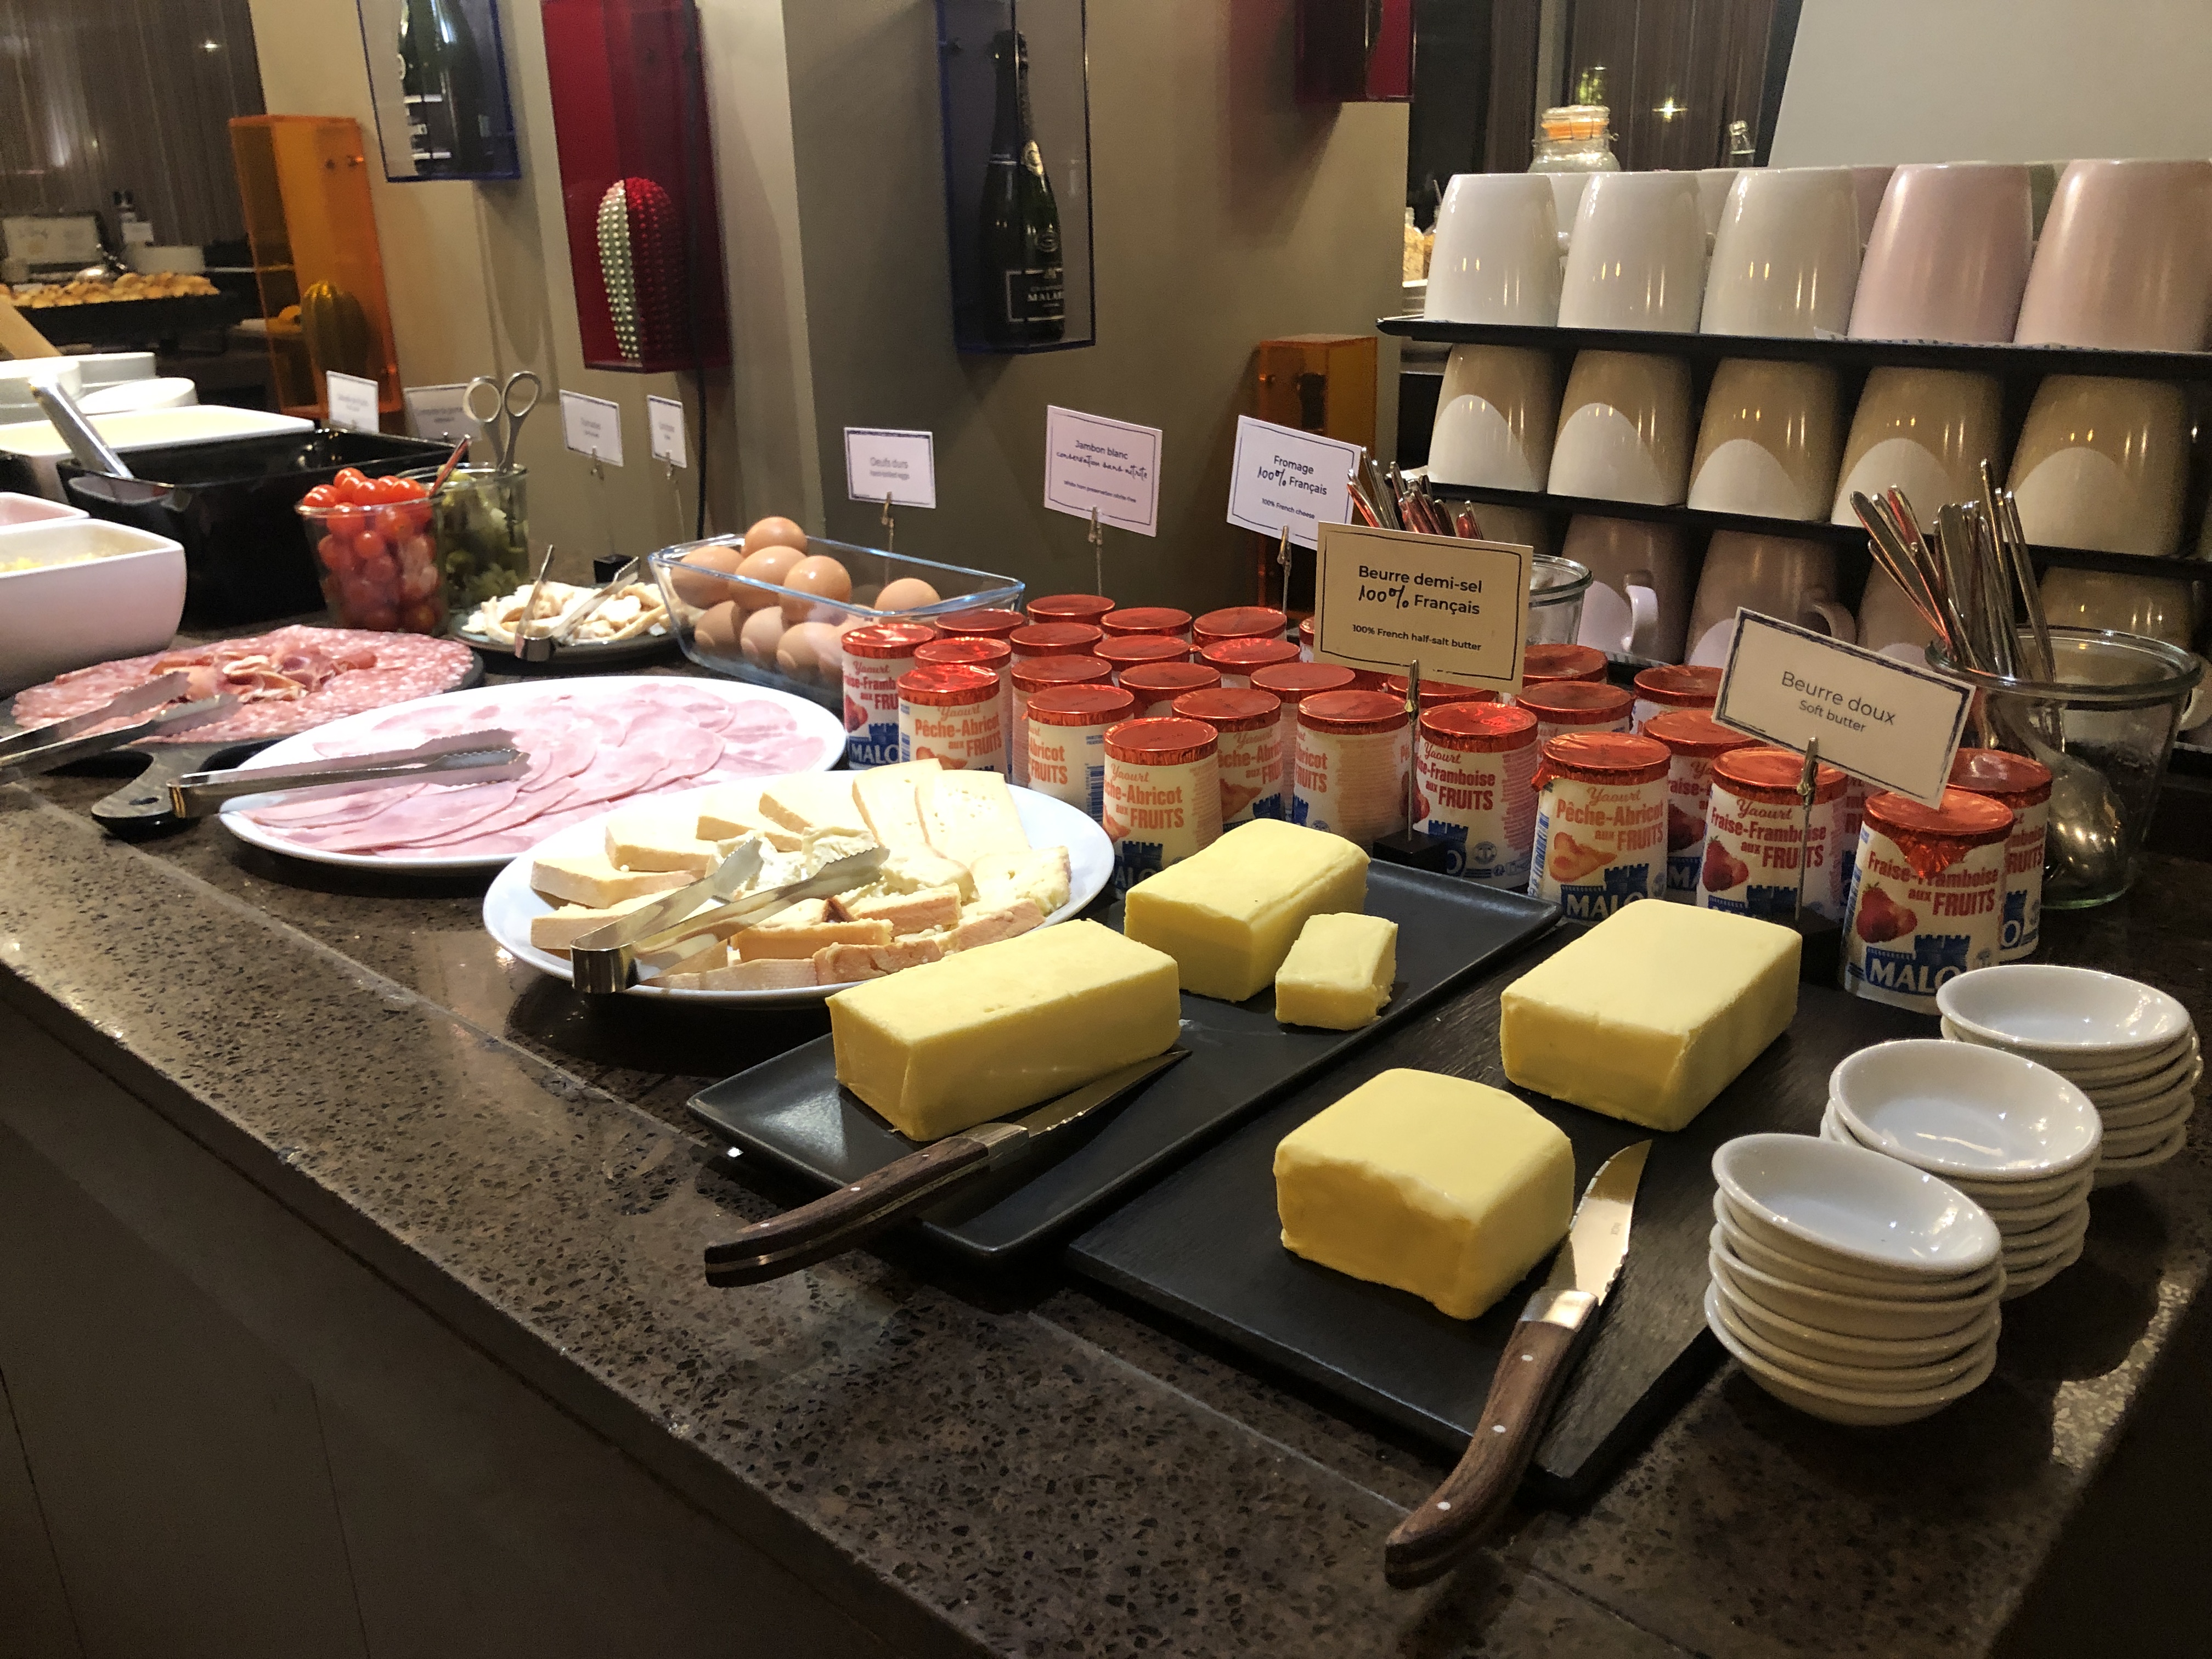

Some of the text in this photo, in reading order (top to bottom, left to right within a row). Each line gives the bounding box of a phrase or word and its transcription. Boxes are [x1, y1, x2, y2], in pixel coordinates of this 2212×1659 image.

[1075, 440, 1128, 460] Jambon blanc
[1274, 455, 1314, 475] Fromage
[1257, 466, 1327, 495] 100% Français
[1262, 498, 1315, 519] 100% French cheese
[1359, 566, 1482, 593] Beurre demi-sel
[1358, 585, 1480, 614] 100% Français
[1352, 624, 1481, 651] 100% French half-salt butter
[853, 661, 890, 675] Yaourt
[1782, 671, 1895, 725] Beurre doux
[915, 712, 1000, 738] Pêche-Abricot
[1799, 699, 1866, 732] Soft butter
[851, 743, 899, 764] MALO
[948, 730, 1002, 757] aux FRUITS
[1424, 742, 1462, 764] Yaourt
[1111, 763, 1149, 782] Yaourt
[1426, 780, 1493, 810] aux FRUITS
[1587, 786, 1642, 806] Yaourt
[1116, 804, 1184, 830] aux FRUITS
[1556, 799, 1664, 826] Pêche-Abricot
[1736, 798, 1792, 820] Yaourt
[1595, 822, 1663, 851] aux FRUITS
[1741, 842, 1824, 869] aux FRUTS
[1908, 888, 1995, 916] aux FRUITS
